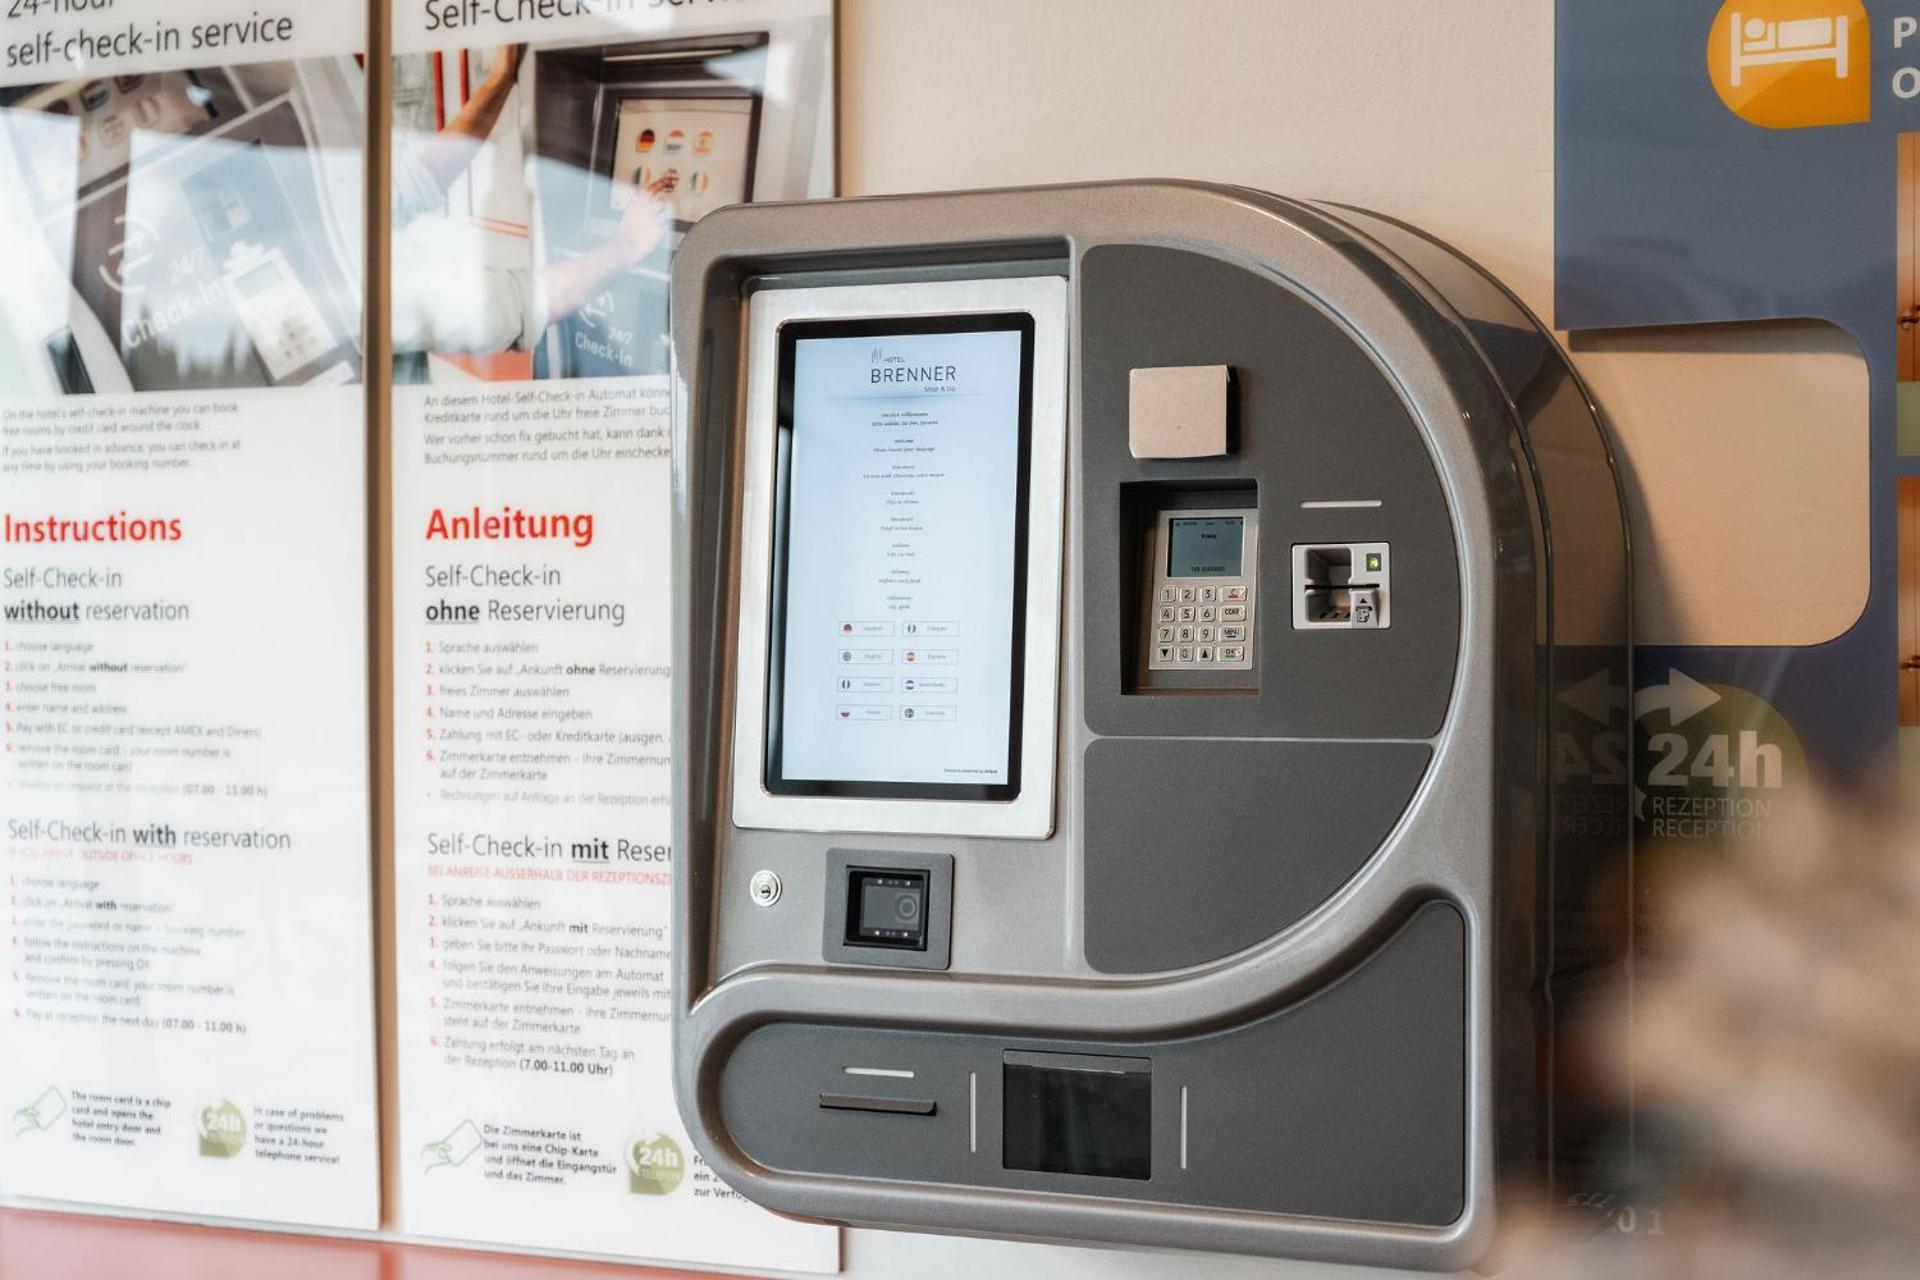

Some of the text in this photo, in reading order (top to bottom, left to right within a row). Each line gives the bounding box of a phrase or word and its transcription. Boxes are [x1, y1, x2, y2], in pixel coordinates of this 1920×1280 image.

[425, 0, 634, 30] Self-Check
[6, 12, 293, 68] self-check-in service
[871, 365, 956, 383] BRENNER
[588, 389, 636, 401] Automat
[424, 410, 480, 422] Kreditkarte
[484, 409, 508, 420] rund
[424, 452, 518, 465] Buchungsnummer
[5, 511, 183, 542] Instructions
[425, 506, 594, 547] Anleitung
[3, 566, 122, 589] Self-Check-in
[425, 564, 561, 587] Self-Check-in
[1165, 589, 1170, 599] 1
[1184, 589, 1191, 599] 2
[1205, 589, 1211, 599] 3
[4, 600, 190, 622] without reservation
[425, 598, 625, 627] ohne Reservierung
[1163, 609, 1170, 619] 4
[1183, 609, 1190, 619] 5
[1203, 609, 1210, 618] 6
[1163, 629, 1169, 638] 7
[1182, 629, 1189, 638] 8
[1202, 629, 1209, 638] 9
[89, 662, 128, 673] without
[478, 664, 492, 674] Sie
[566, 664, 596, 675] ohne
[497, 708, 538, 719] Adresse
[556, 731, 615, 743] Kreditkarte
[440, 751, 506, 763] Zimmerkarte
[510, 752, 571, 764] entnehmen
[1648, 730, 1782, 788] 24h
[1652, 798, 1771, 817] REZEPTION
[8, 819, 291, 850] Self-Check-in with reservation
[1652, 819, 1773, 839] RECEPTION
[428, 832, 563, 859] Self-Check-in
[571, 837, 609, 861] mit
[494, 867, 563, 882] AUSSERHALB
[567, 869, 589, 882] DER
[95, 900, 117, 911] with
[569, 922, 588, 934] mit
[616, 969, 664, 982] Automat
[300, 1110, 344, 1122] problems
[484, 1124, 582, 1141] Die Zimmerkarte ist
[255, 1149, 302, 1162] telephone
[484, 1140, 599, 1158] bei uns eine Chip-Karte
[639, 1147, 679, 1168] 24h
[538, 1157, 554, 1168] die
[557, 1159, 617, 1174] Eingangstür
[484, 1170, 565, 1184] und das Zimmer.
[694, 1172, 710, 1182] ein
[694, 1187, 710, 1197] zur
